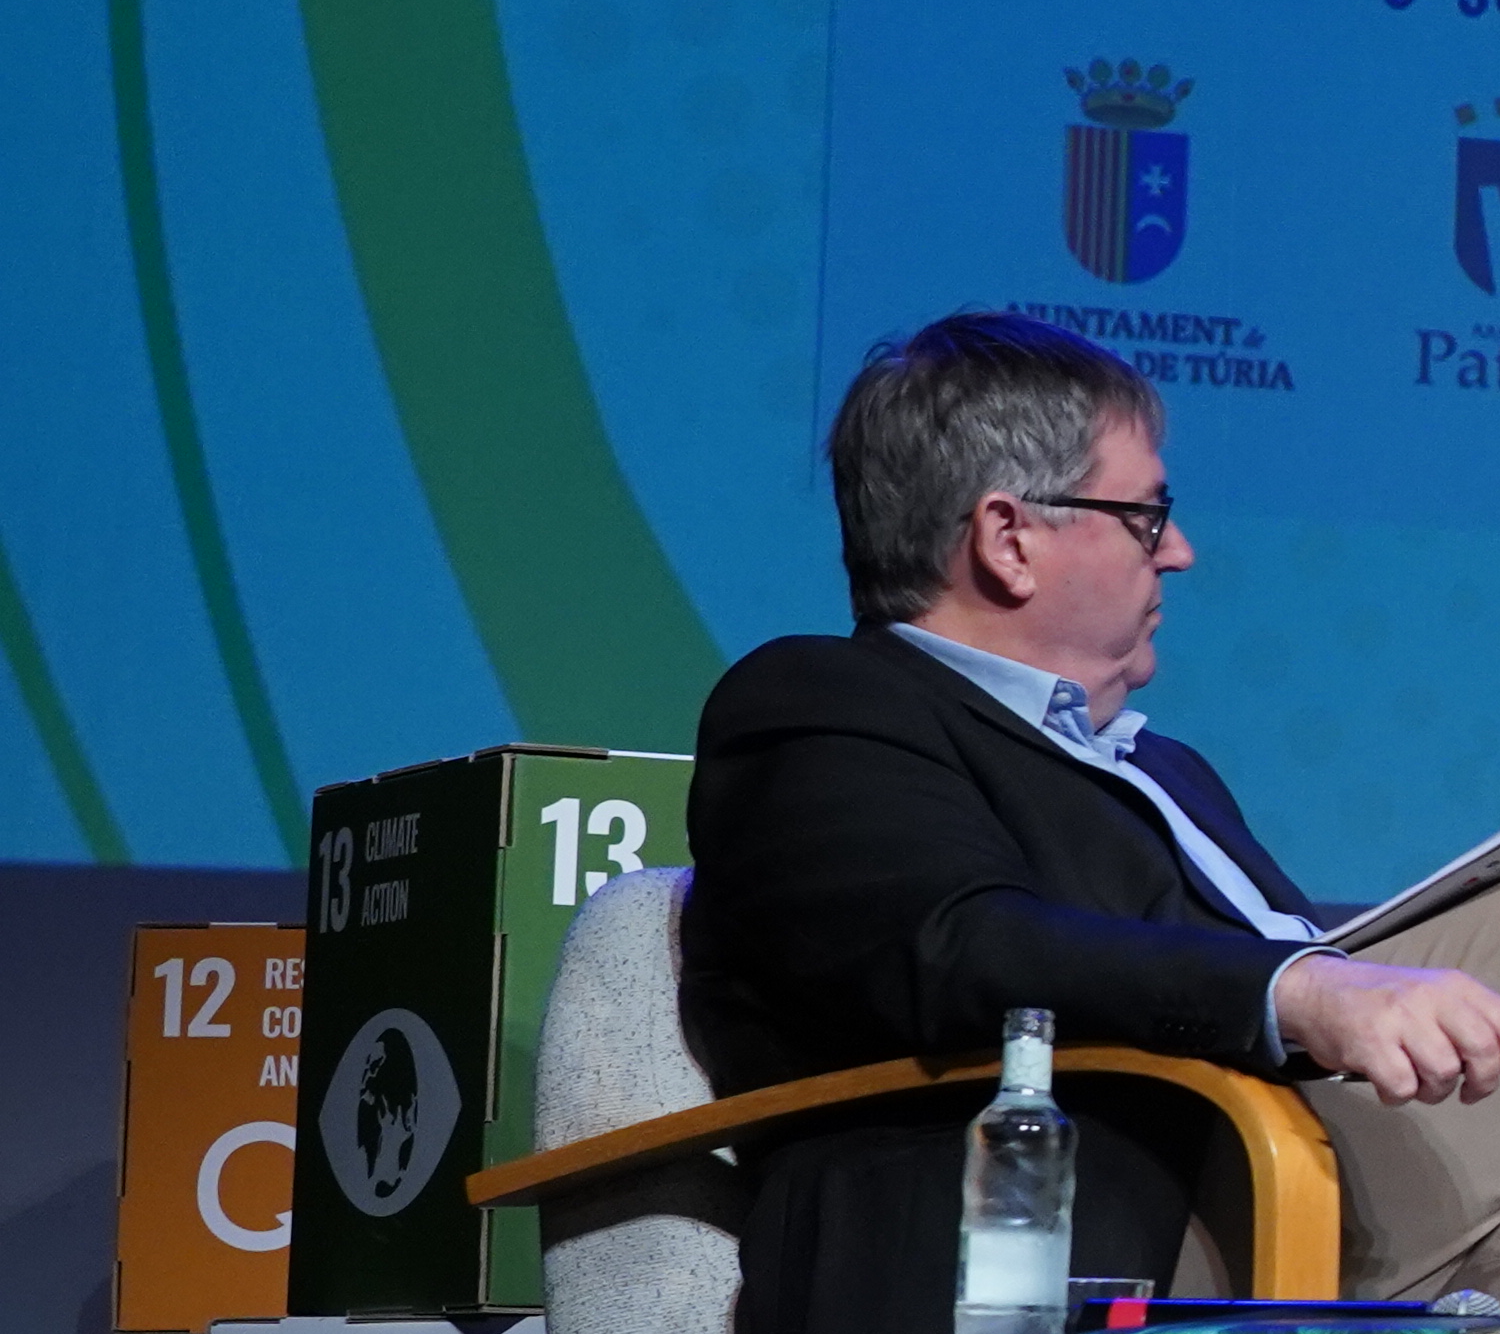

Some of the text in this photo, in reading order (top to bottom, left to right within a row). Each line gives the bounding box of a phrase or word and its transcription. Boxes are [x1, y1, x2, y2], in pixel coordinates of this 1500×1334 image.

[1134, 350, 1295, 391] DE TÚRIA
[318, 812, 421, 934] 13 CLIMATE
[540, 797, 648, 906] 13
[360, 878, 409, 928] ACTION
[153, 956, 237, 1038] 12
